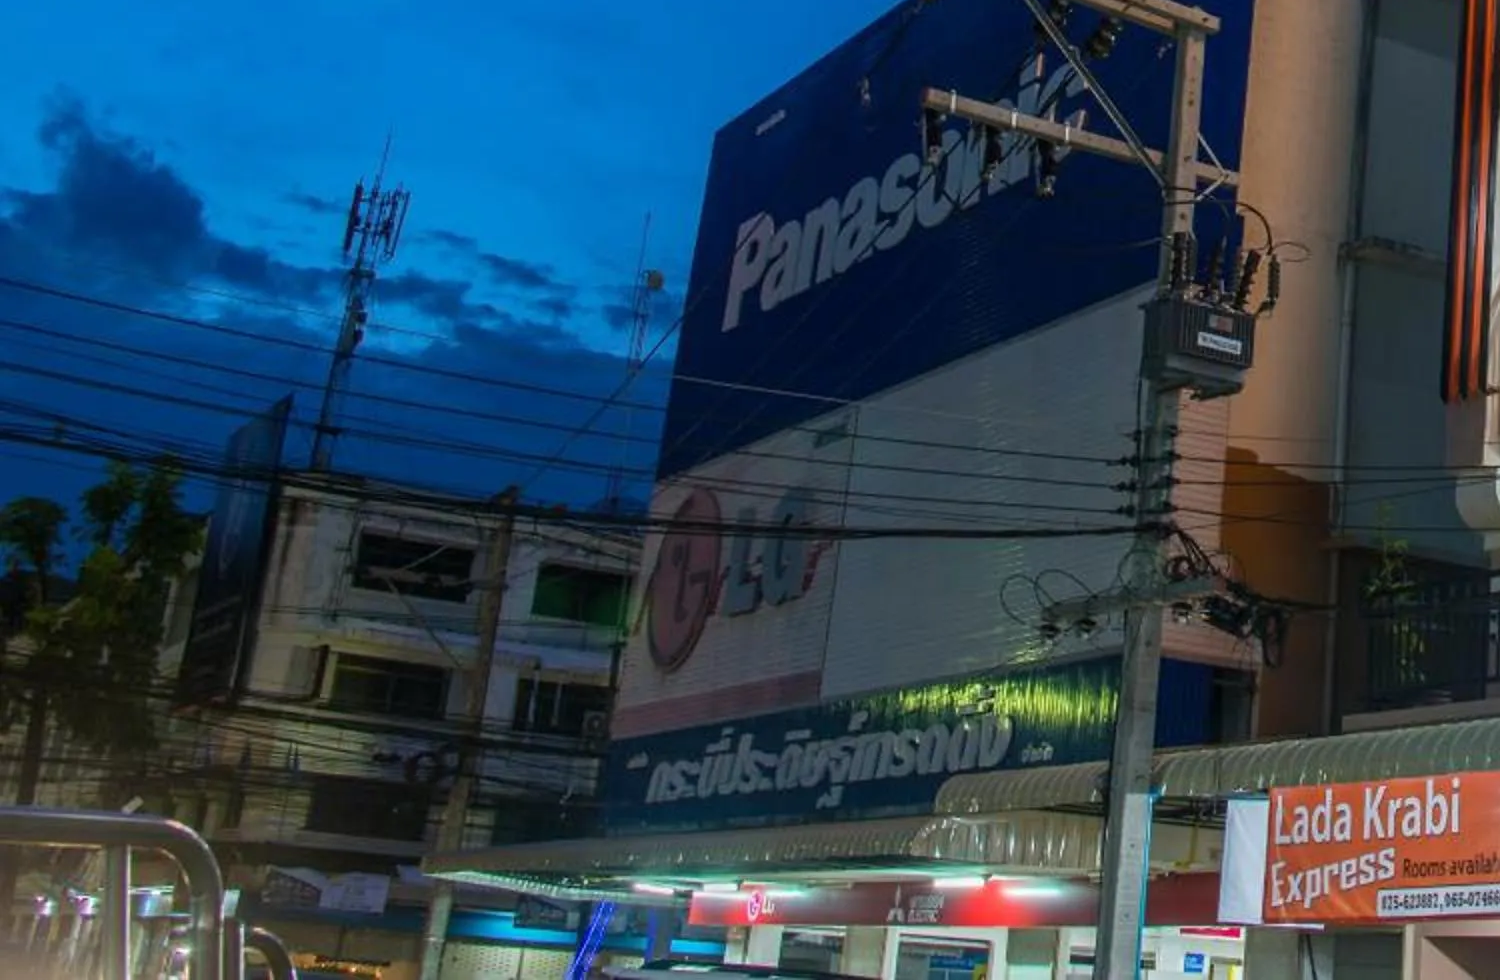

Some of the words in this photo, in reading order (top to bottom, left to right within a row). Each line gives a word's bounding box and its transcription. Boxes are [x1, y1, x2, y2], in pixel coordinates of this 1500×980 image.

[1274, 787, 1352, 845] Lada
[1364, 777, 1460, 840] Krabi
[1271, 847, 1395, 908] Express
[1403, 856, 1446, 878] Rooms
